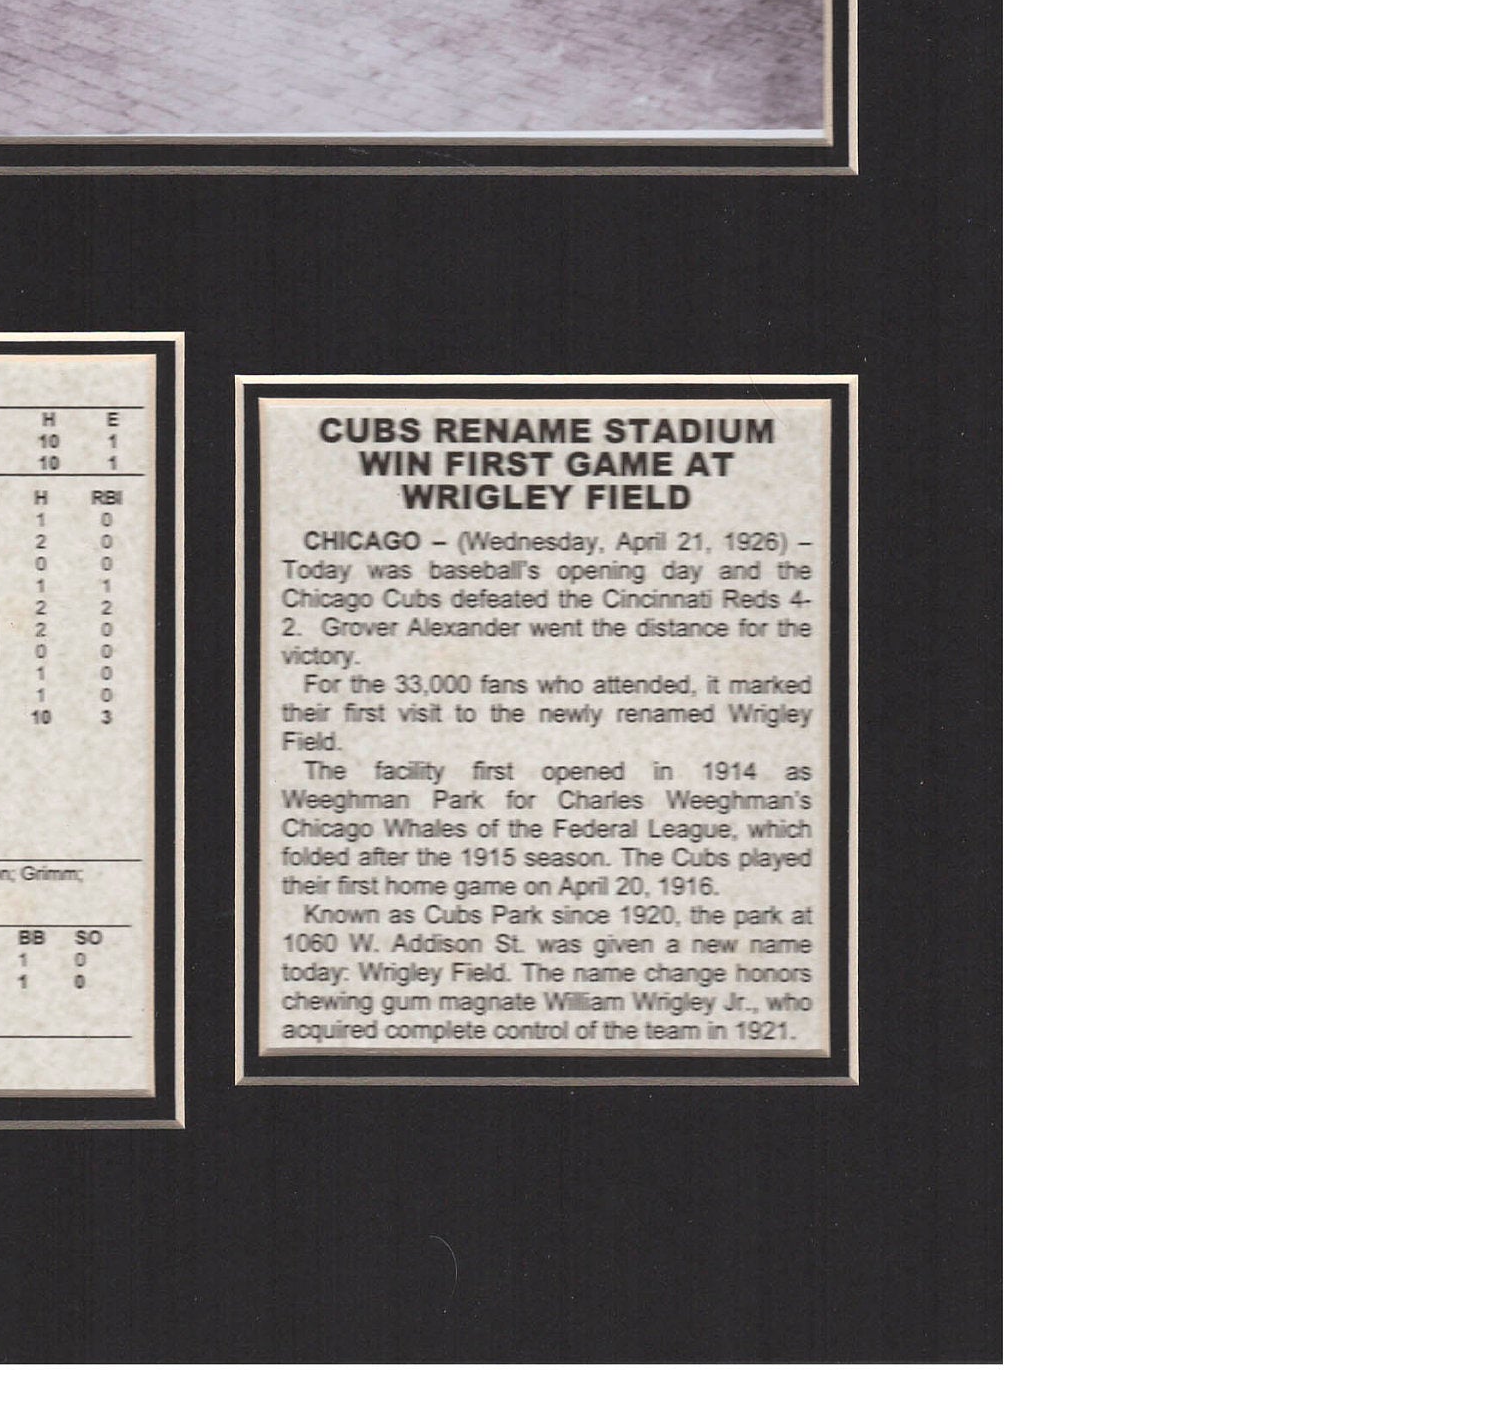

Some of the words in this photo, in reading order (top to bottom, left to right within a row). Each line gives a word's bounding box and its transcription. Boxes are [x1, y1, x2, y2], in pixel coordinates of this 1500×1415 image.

[42, 412, 56, 427] H
[106, 411, 120, 427] E
[318, 417, 422, 444] CUBS
[434, 417, 592, 444] RENAME
[603, 417, 776, 445] STADIUM
[357, 450, 432, 477] WIN
[445, 450, 554, 478] FIRST
[564, 450, 674, 478] GAME
[684, 451, 736, 478] AT
[34, 489, 48, 505] H
[91, 489, 123, 506] RBI
[400, 483, 574, 511] WRIGLEY
[585, 484, 692, 511] FIELD
[303, 530, 421, 551] CHICAGO
[457, 530, 604, 556] (Wednesday,
[615, 531, 667, 556] April
[677, 531, 711, 552] 21,
[724, 531, 788, 556] 1926)
[281, 559, 352, 585] Today
[366, 564, 413, 580] was
[429, 560, 541, 580] baseball's
[557, 560, 646, 585] opening
[662, 560, 703, 585] day
[719, 560, 761, 581] and
[776, 560, 812, 581] the
[35, 599, 47, 616] 2
[101, 600, 112, 616] 2
[281, 587, 374, 614] Chicago
[382, 587, 442, 609] Cubs
[450, 588, 549, 609] defeated
[558, 589, 593, 609] the
[602, 588, 712, 609] Cincinnati
[722, 588, 781, 610] Reds
[789, 589, 812, 608] 4-
[304, 673, 342, 694] For
[349, 674, 386, 694] the
[395, 674, 472, 695] 33,000
[480, 674, 529, 695] fans
[536, 675, 584, 695] who
[592, 674, 697, 695] attended,
[707, 674, 721, 695] it
[729, 675, 812, 695] marked
[31, 709, 52, 725] 10
[101, 709, 113, 725] 3
[281, 703, 331, 723] their
[343, 702, 386, 723] first
[398, 703, 443, 723] visit
[454, 704, 477, 723] to
[490, 703, 526, 724] the
[539, 703, 603, 728] newly
[617, 703, 715, 724] renamed
[728, 703, 813, 729] Wrigley
[281, 789, 410, 815] Weeghman
[433, 789, 484, 810] Park
[505, 789, 537, 810] for
[558, 789, 644, 810] Charles
[665, 789, 812, 815] Weeghman's
[282, 817, 374, 843] Chicago
[383, 818, 468, 839] Whales
[477, 818, 500, 839] of
[507, 819, 543, 839] the
[553, 818, 638, 839] Federal
[648, 819, 737, 844] League,
[747, 819, 812, 839] which
[304, 904, 380, 924] Known
[388, 908, 415, 925] as
[424, 904, 483, 925] Cubs
[492, 904, 543, 925] Park
[551, 905, 610, 925] since
[620, 904, 681, 925] 1920,
[689, 905, 726, 925] the
[734, 905, 783, 930] park
[791, 906, 813, 925] at
[18, 929, 46, 946] BB
[74, 929, 103, 946] SO
[283, 932, 337, 953] 1060
[349, 933, 379, 953] W.
[391, 933, 483, 954] Addison
[495, 933, 525, 954] St.
[537, 938, 582, 954] was
[594, 934, 654, 959] given
[665, 938, 680, 954] a
[692, 938, 739, 954] new
[750, 938, 813, 954] name
[282, 991, 374, 1016] chewing
[381, 995, 431, 1016] gum
[438, 992, 537, 1016] magnate
[543, 991, 624, 1012] William
[632, 991, 716, 1017] Wrigley
[723, 992, 759, 1012] Jr.,
[765, 992, 813, 1012] who
